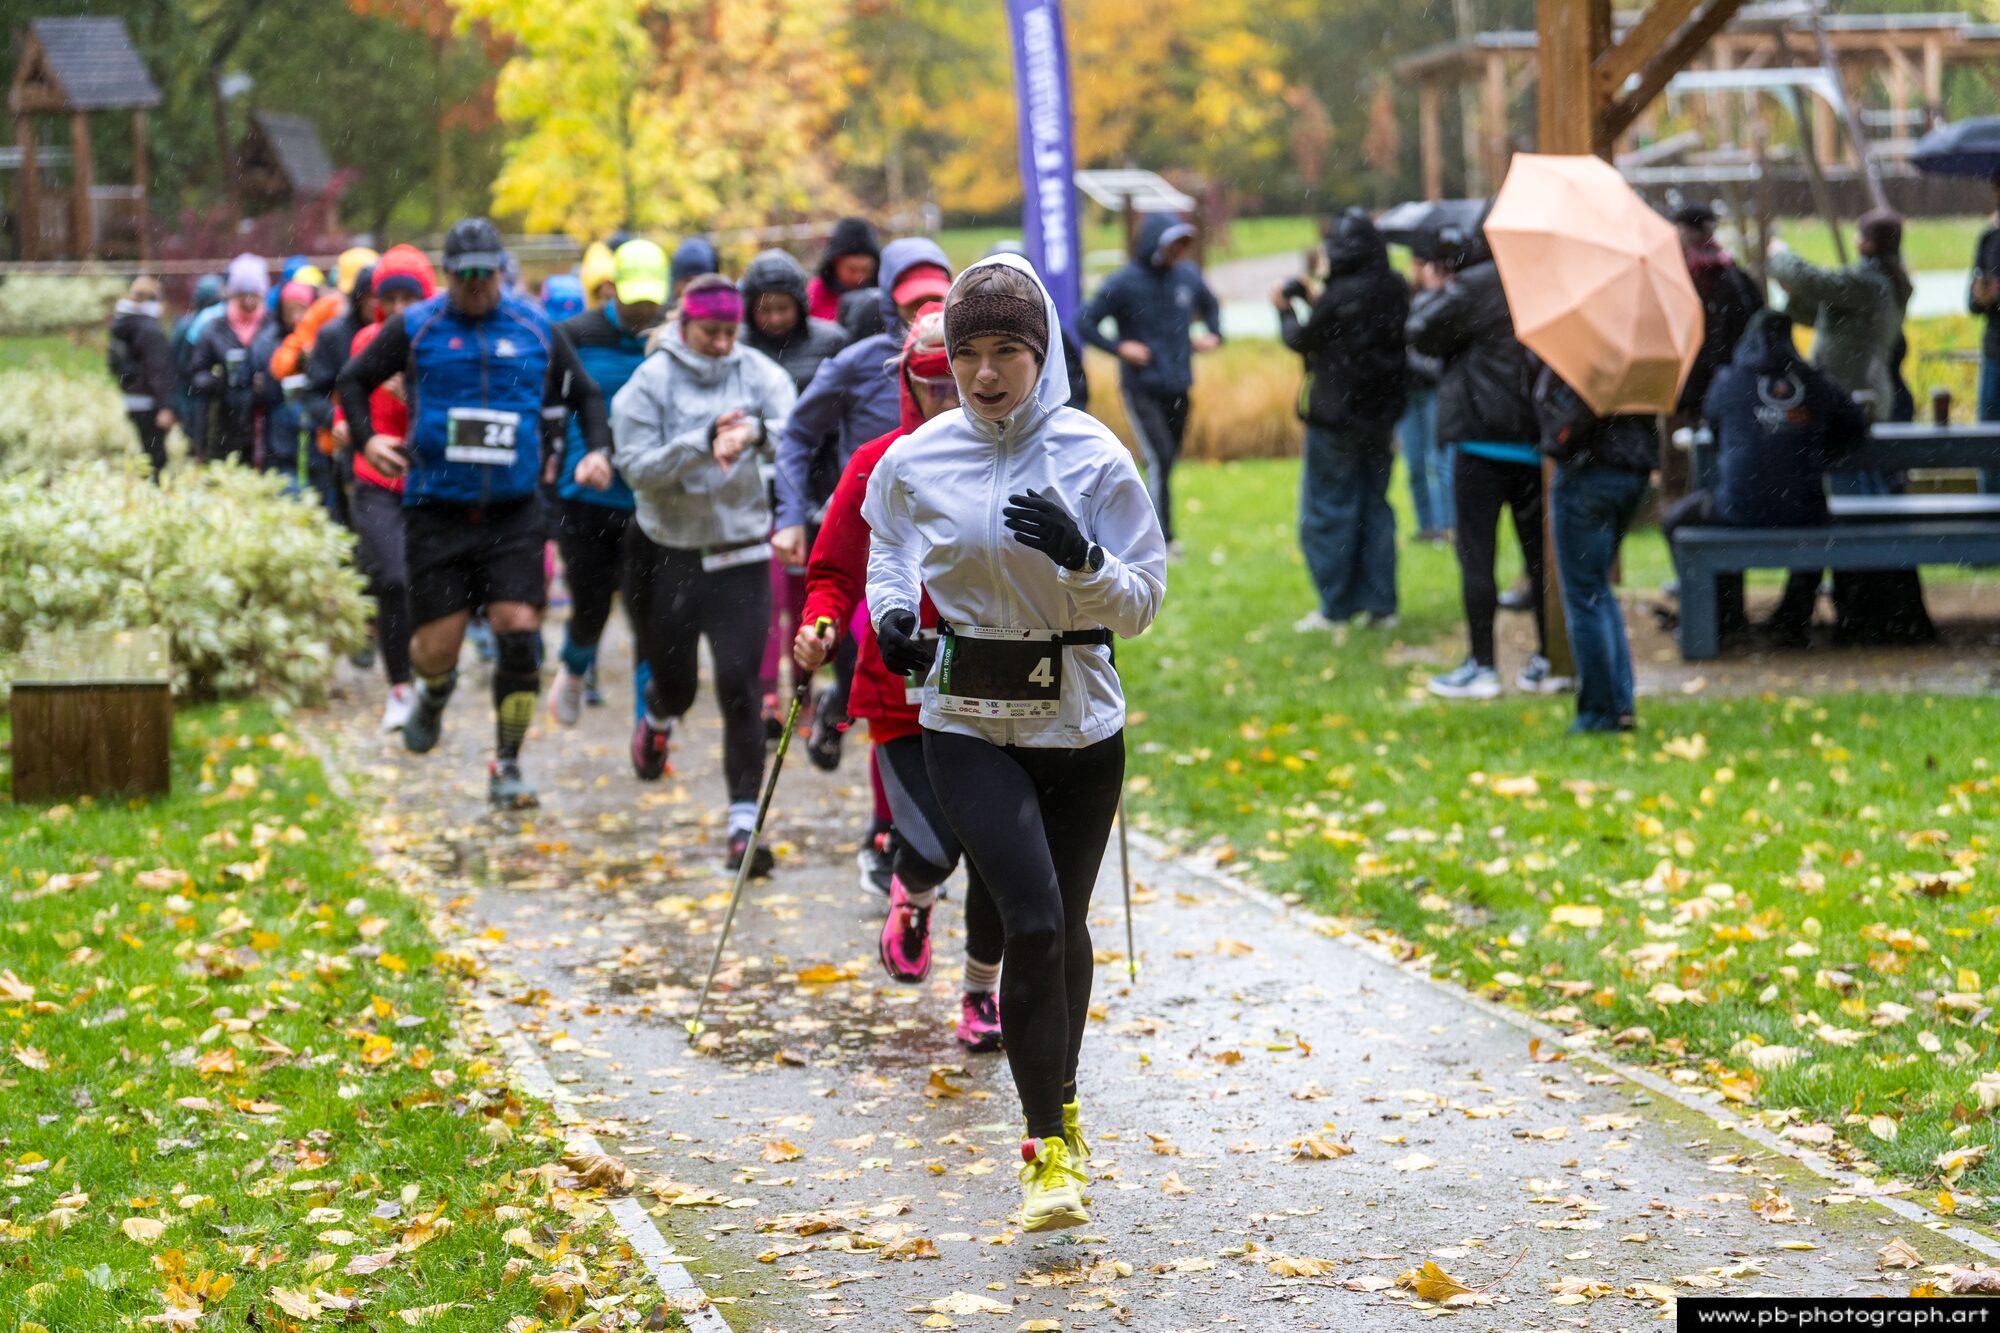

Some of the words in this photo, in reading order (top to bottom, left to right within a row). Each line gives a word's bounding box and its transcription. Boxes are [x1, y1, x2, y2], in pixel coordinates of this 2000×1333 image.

[482, 423, 515, 447] 24
[944, 648, 952, 666] 10:00
[1028, 657, 1055, 687] 4
